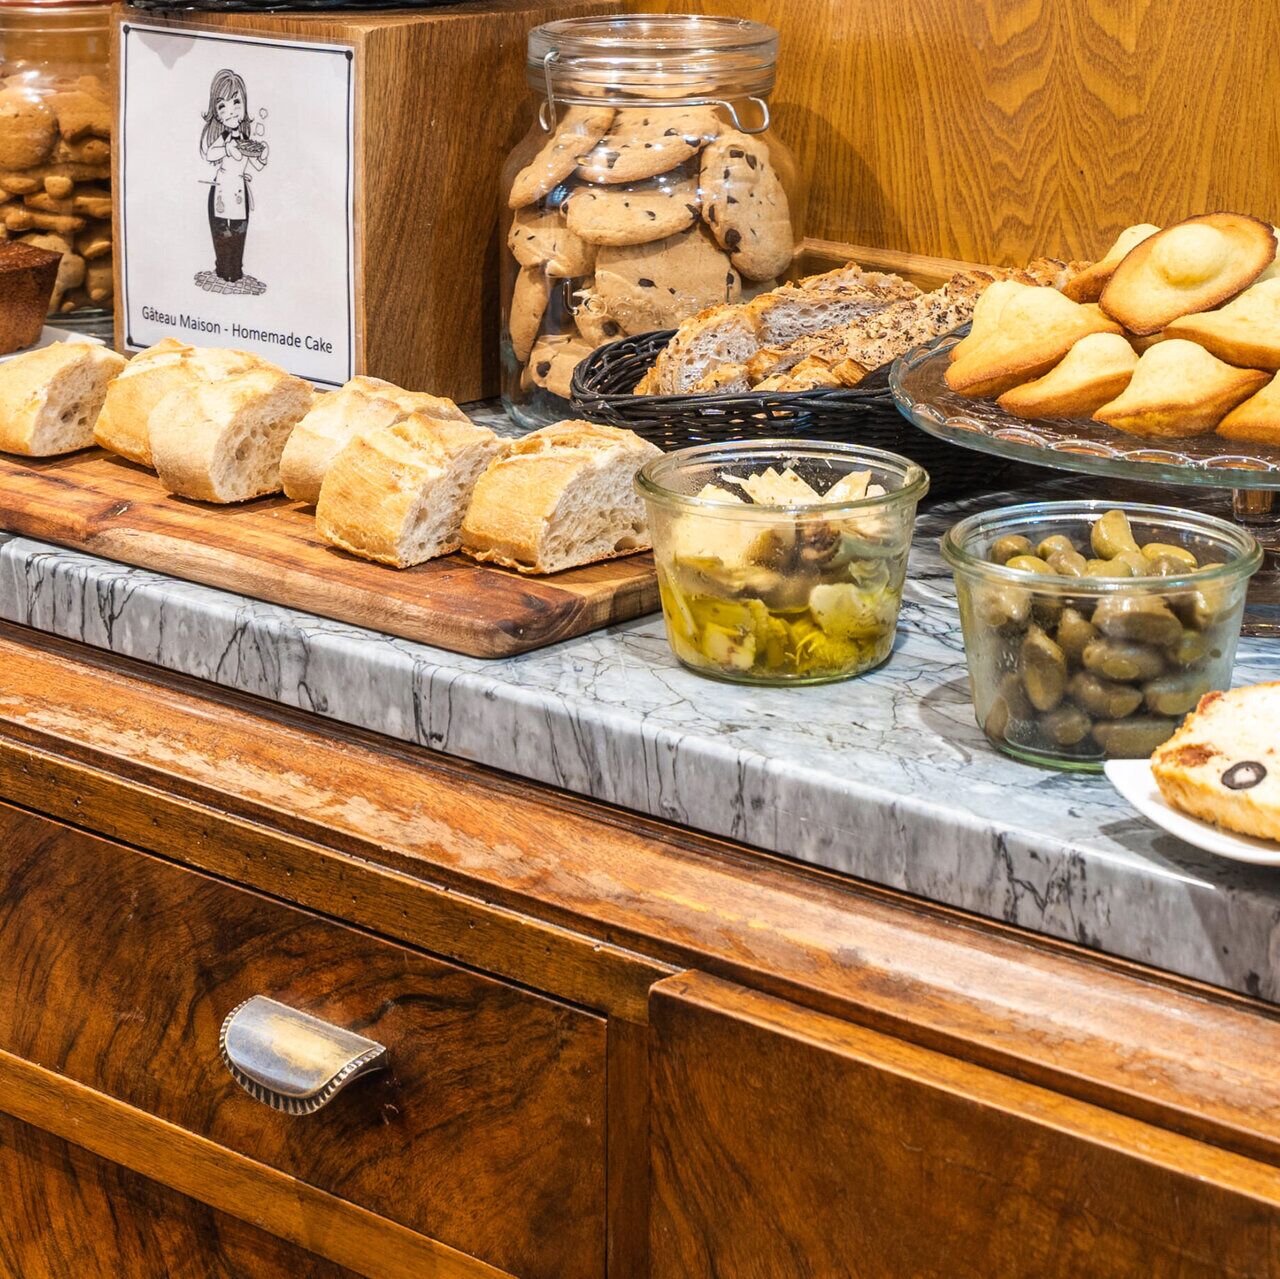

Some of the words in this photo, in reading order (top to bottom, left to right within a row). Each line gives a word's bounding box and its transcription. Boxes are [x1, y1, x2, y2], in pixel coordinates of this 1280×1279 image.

[141, 305, 177, 326] Gâteau
[179, 313, 221, 334] Maison
[232, 323, 302, 348] Homemade
[304, 335, 333, 354] Cake
